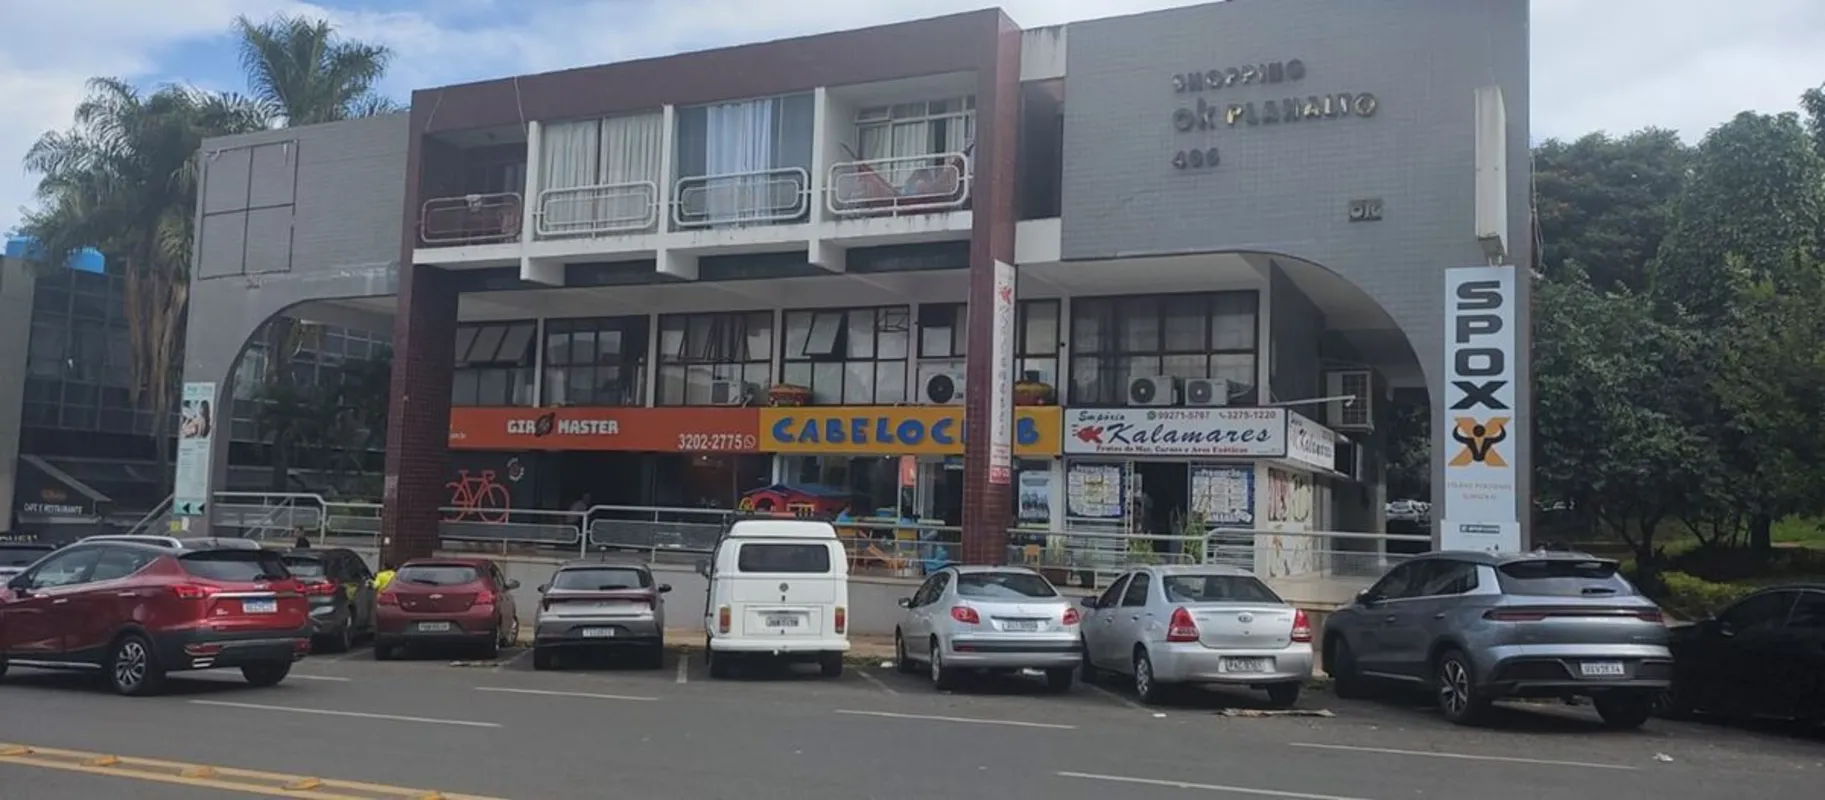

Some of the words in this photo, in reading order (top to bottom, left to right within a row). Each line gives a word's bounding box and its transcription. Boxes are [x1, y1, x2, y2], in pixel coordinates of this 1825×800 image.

[1172, 58, 1306, 93] SHOPPING
[1224, 92, 1378, 128] PLANALTO
[1449, 280, 1510, 410] SPOX
[558, 419, 619, 435] MASTER
[677, 433, 743, 451] 3202-2775
[772, 416, 1040, 446] CABELOCB
[1106, 423, 1272, 446] Kalamares
